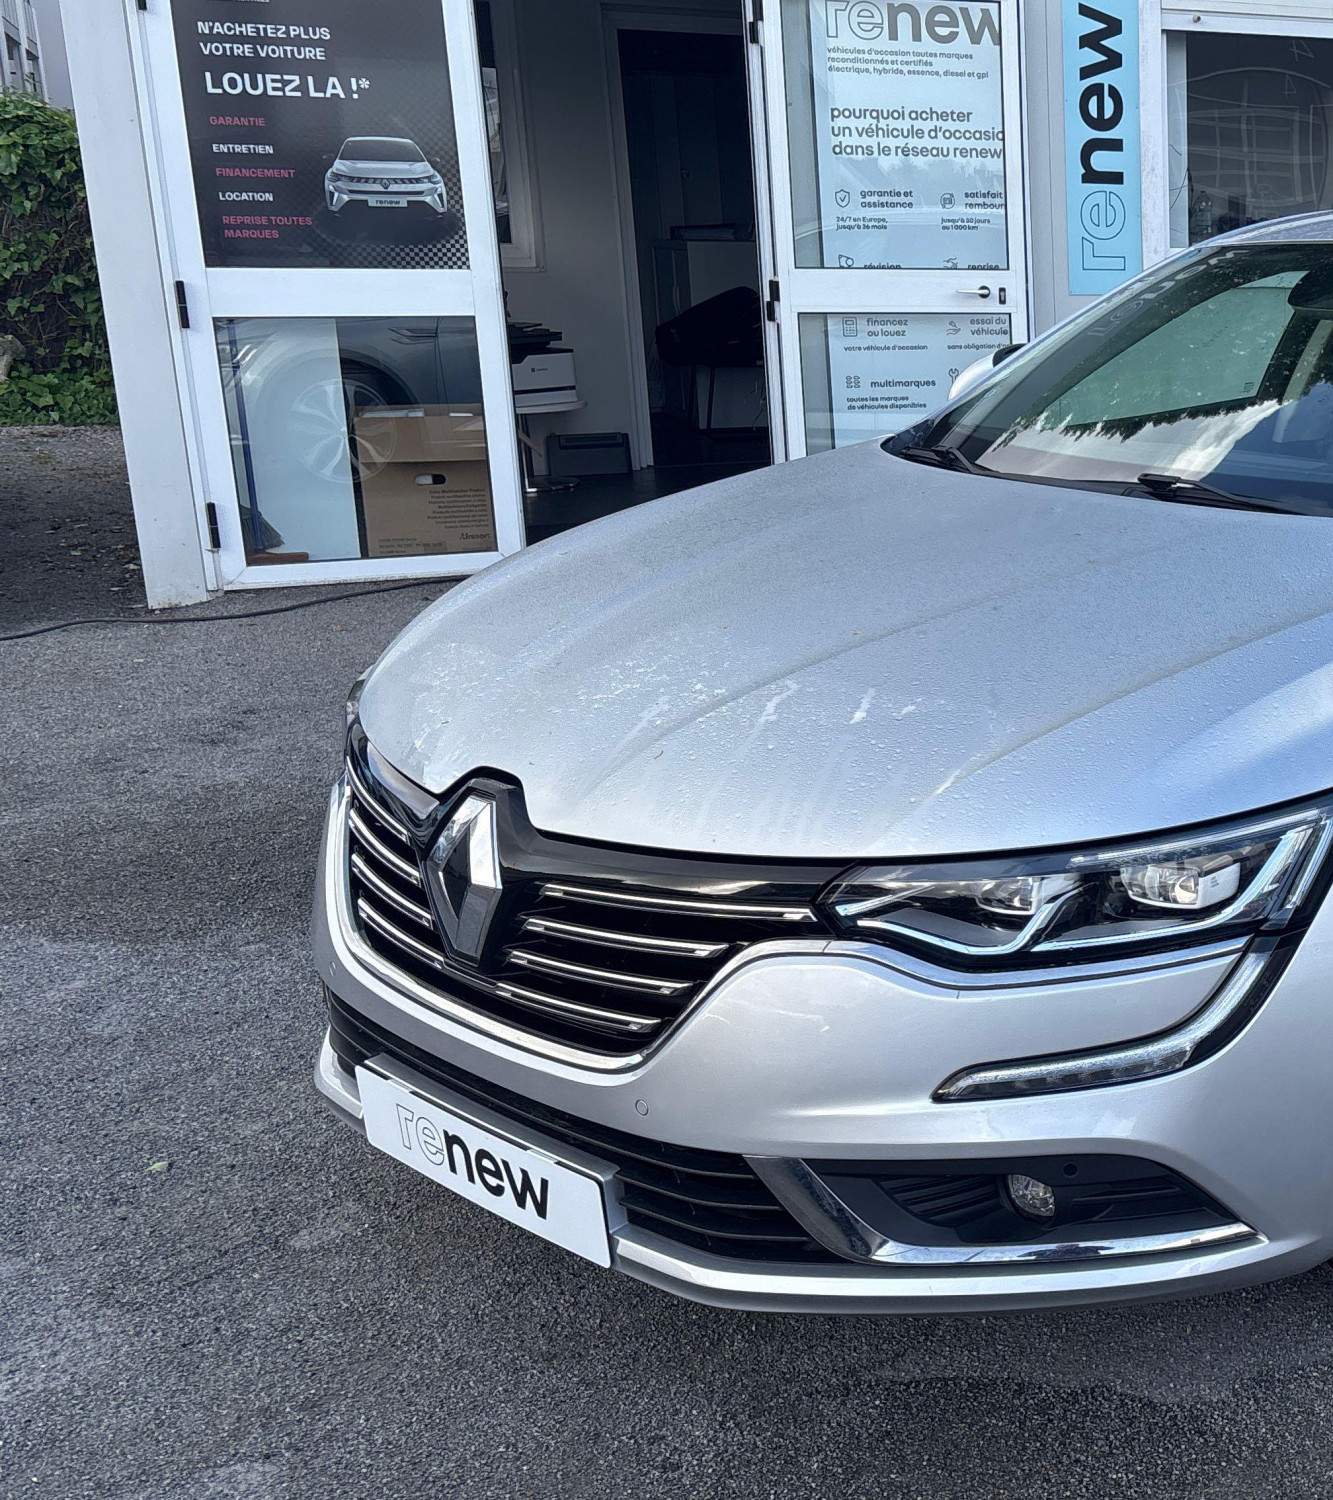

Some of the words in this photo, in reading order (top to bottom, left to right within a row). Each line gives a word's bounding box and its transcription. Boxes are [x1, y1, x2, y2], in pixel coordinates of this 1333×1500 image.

[197, 21, 287, 38] N'ACHETEZ
[290, 26, 331, 40] PLUS
[199, 42, 255, 57] VOTRE
[256, 45, 326, 60] VOITURE
[827, 47, 866, 55] véhicules
[867, 48, 911, 57] d'occasion
[939, 52, 973, 60] marques
[828, 56, 889, 66] reconditionnés
[900, 59, 933, 67] certifiés
[828, 65, 872, 75] électrique,
[873, 67, 906, 76] hybride,
[907, 69, 942, 78] essence,
[943, 69, 966, 78] diesel
[976, 71, 989, 80] gpl
[204, 71, 302, 97] LOUEZ
[307, 76, 346, 99] LA
[830, 106, 905, 124] pourquoi
[908, 107, 973, 123] acheter
[209, 116, 266, 127] GARANTIE
[831, 126, 852, 138] un
[855, 123, 925, 139] véhicule
[1078, 2, 1127, 271] renew
[212, 144, 274, 154] ENTRETIEN
[832, 141, 874, 157] dans
[877, 142, 892, 157] le
[895, 143, 950, 158] réseau
[953, 147, 1003, 159] renew
[215, 168, 295, 178] FINANCEMENT
[219, 191, 273, 202] LOCATION
[860, 189, 902, 199] garantie
[903, 190, 914, 198] et
[964, 190, 1003, 199] satisfait
[860, 200, 914, 209] assistance
[222, 215, 270, 225] REPRISE
[271, 216, 313, 226] TOUTES
[836, 216, 852, 224] 24/7
[862, 216, 888, 224] Europe,
[224, 229, 279, 239] MARQUES
[867, 318, 908, 326] financez
[970, 318, 994, 326] essai
[995, 317, 1007, 325] du
[881, 328, 906, 337] louez
[970, 327, 1008, 336] véhicule
[870, 378, 936, 389] multimarques
[880, 395, 909, 403] marques
[889, 402, 927, 410] disponibles
[396, 1103, 549, 1220] renew
